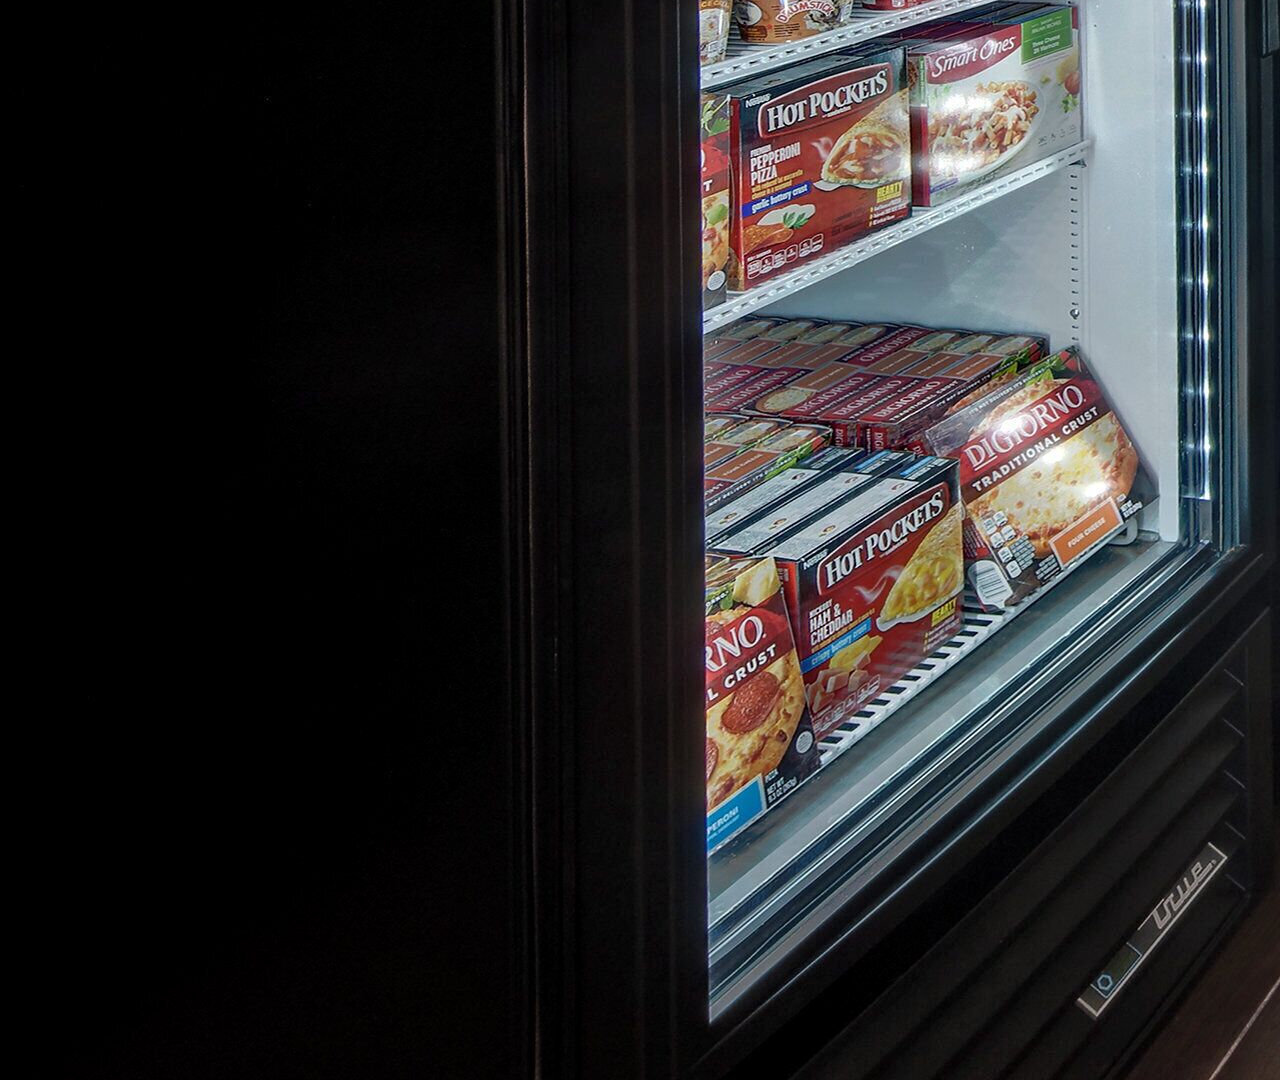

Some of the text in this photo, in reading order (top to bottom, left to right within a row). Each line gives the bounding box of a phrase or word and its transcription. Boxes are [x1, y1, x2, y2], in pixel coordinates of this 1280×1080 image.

[931, 35, 1017, 78] Smart Ones
[767, 70, 888, 132] HOT POCKETS
[750, 141, 801, 172] PEPPERONI
[750, 164, 778, 187] PIZZA
[972, 406, 1100, 493] TRADITIONAL CRUST
[825, 491, 946, 589] HOT POCKETS
[810, 603, 841, 633] HAM &
[810, 609, 854, 646] CHEDDAR
[723, 643, 778, 689] CRUST
